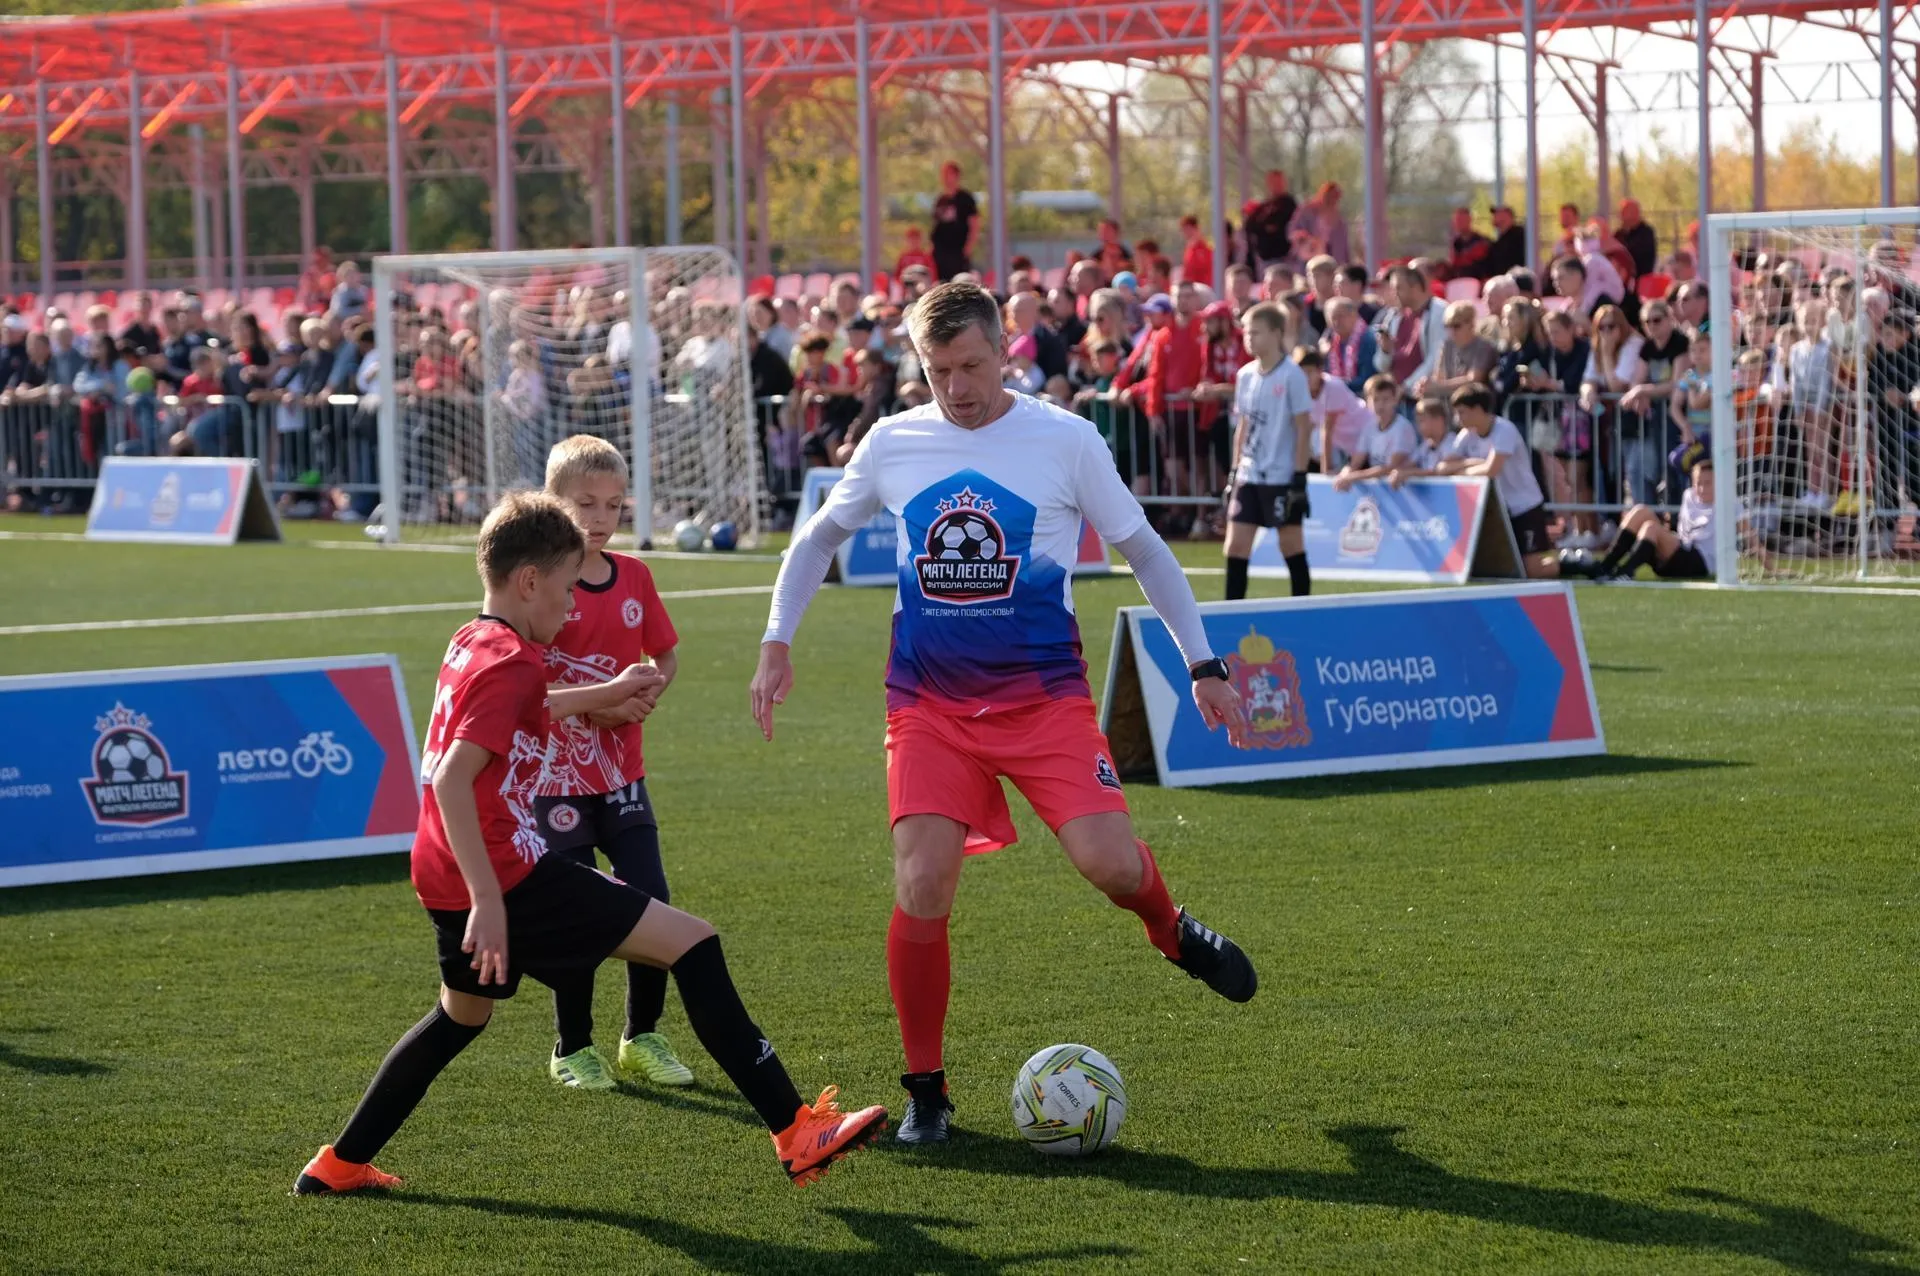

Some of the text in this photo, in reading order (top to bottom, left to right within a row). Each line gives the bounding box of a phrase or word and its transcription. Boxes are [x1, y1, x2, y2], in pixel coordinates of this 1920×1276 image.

[923, 563, 1008, 580] МАТЧ ЛЕГЕНД
[926, 581, 1003, 589] ФУТБОЛА РОССИИ
[960, 607, 1015, 617] ПОДМОСКОВЬЯ
[1315, 655, 1437, 685] Команда
[1324, 694, 1498, 734] Губернатора
[217, 747, 288, 771] лето
[95, 780, 180, 804] МАТЧ ЛЕГЕНД
[1056, 1081, 1081, 1108] TORRES
